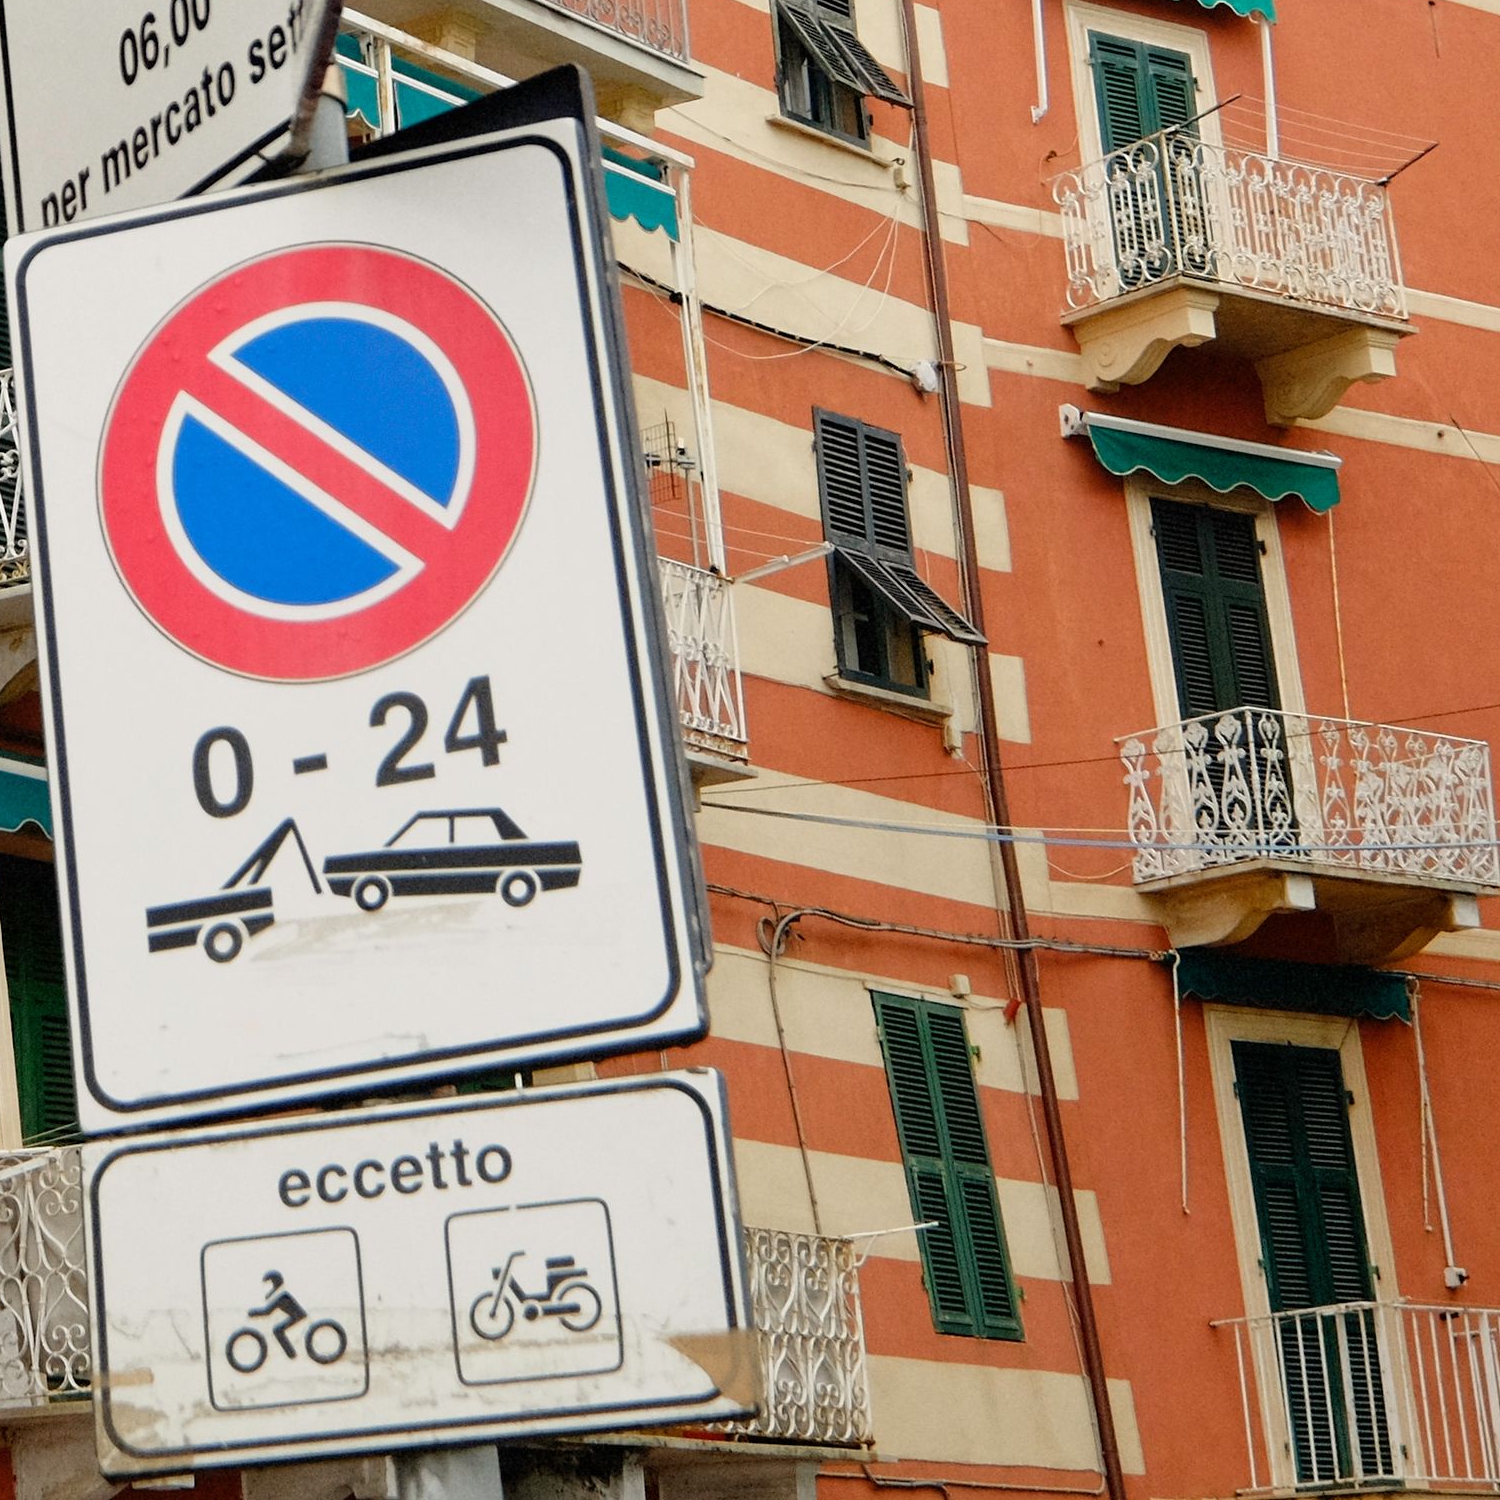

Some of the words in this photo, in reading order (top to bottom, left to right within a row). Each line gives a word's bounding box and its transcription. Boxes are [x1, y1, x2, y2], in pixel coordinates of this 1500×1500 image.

[101, 61, 236, 194] mercato
[193, 727, 254, 819] 0
[293, 754, 328, 775] -
[369, 676, 508, 788] 24
[278, 1140, 513, 1208] eccetto
